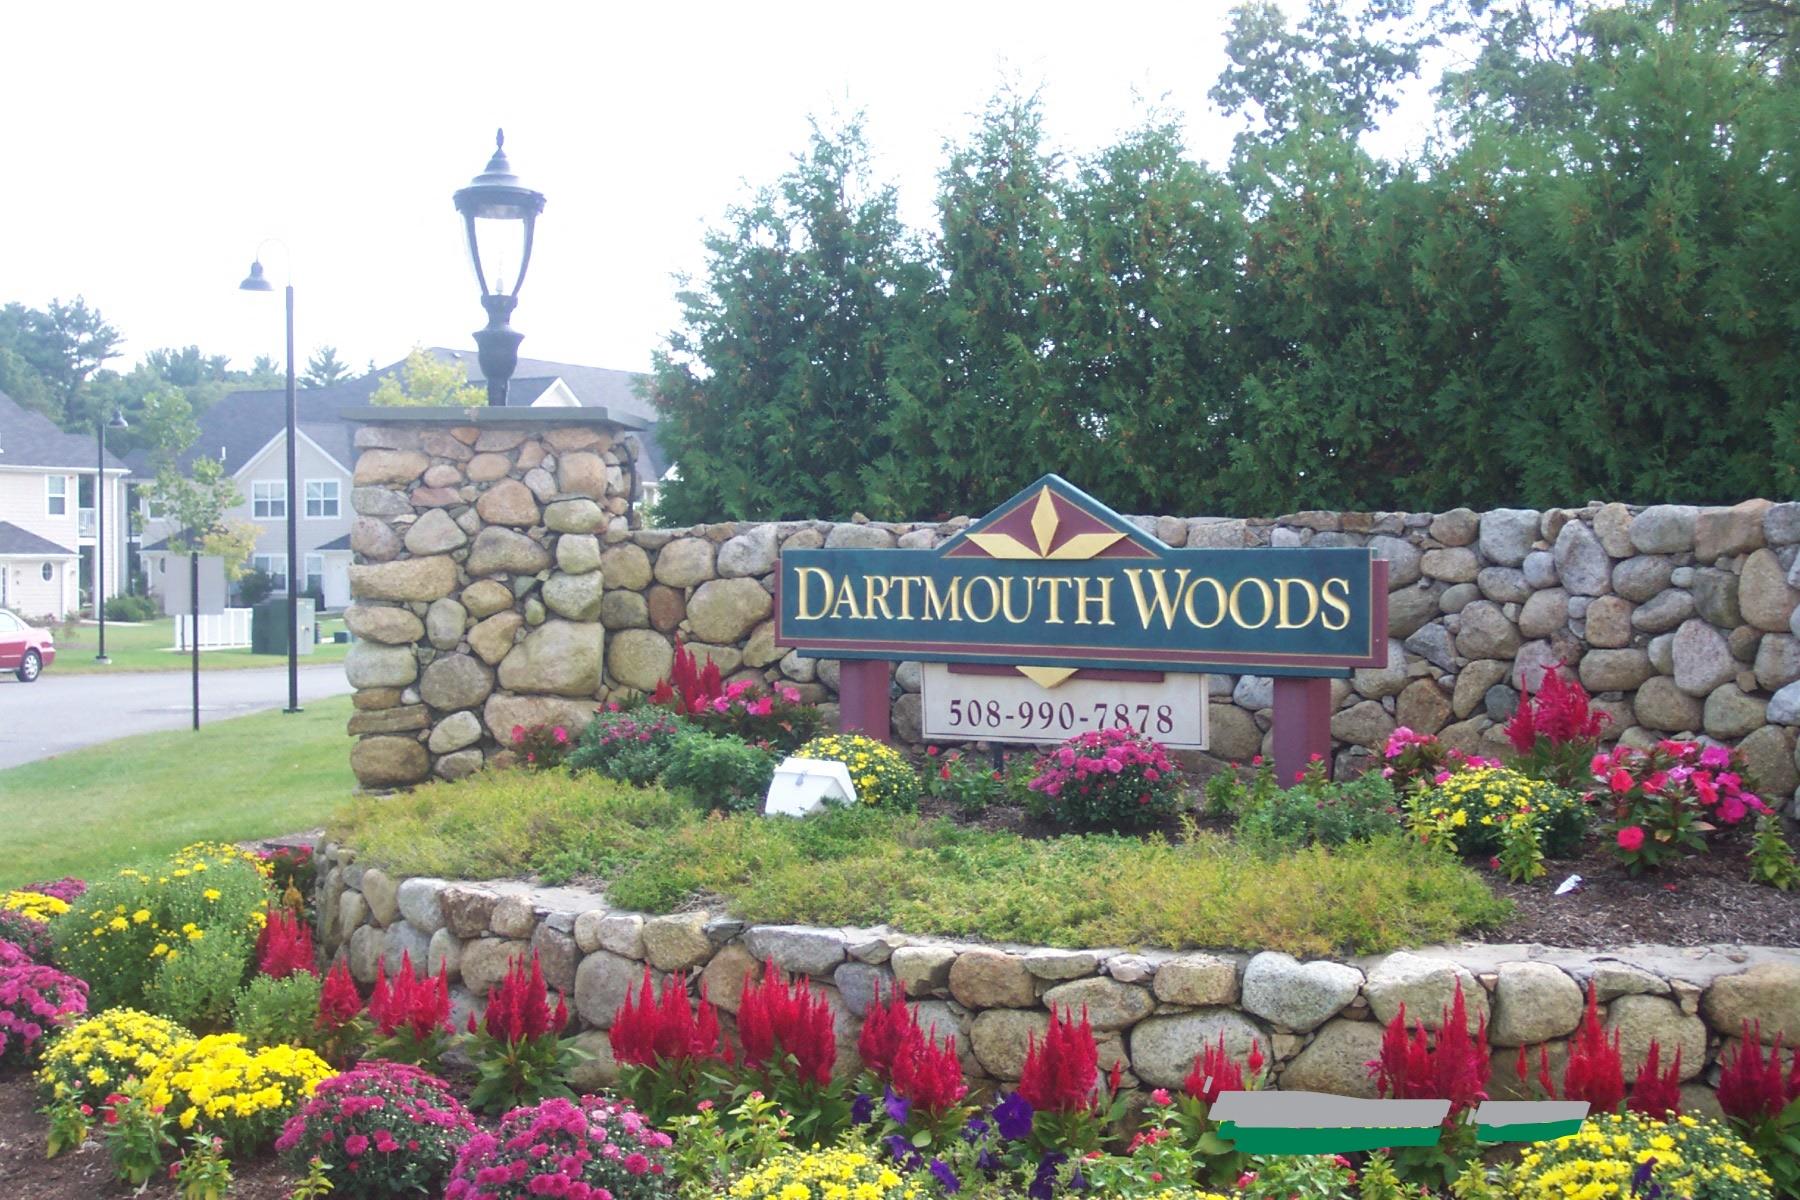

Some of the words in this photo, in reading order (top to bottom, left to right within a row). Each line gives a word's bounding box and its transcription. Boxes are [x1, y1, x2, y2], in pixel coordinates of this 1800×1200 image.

[793, 566, 1115, 625] DARTMOUTH
[1123, 568, 1351, 630] WOODS
[948, 699, 1174, 734] 508-990-7878
